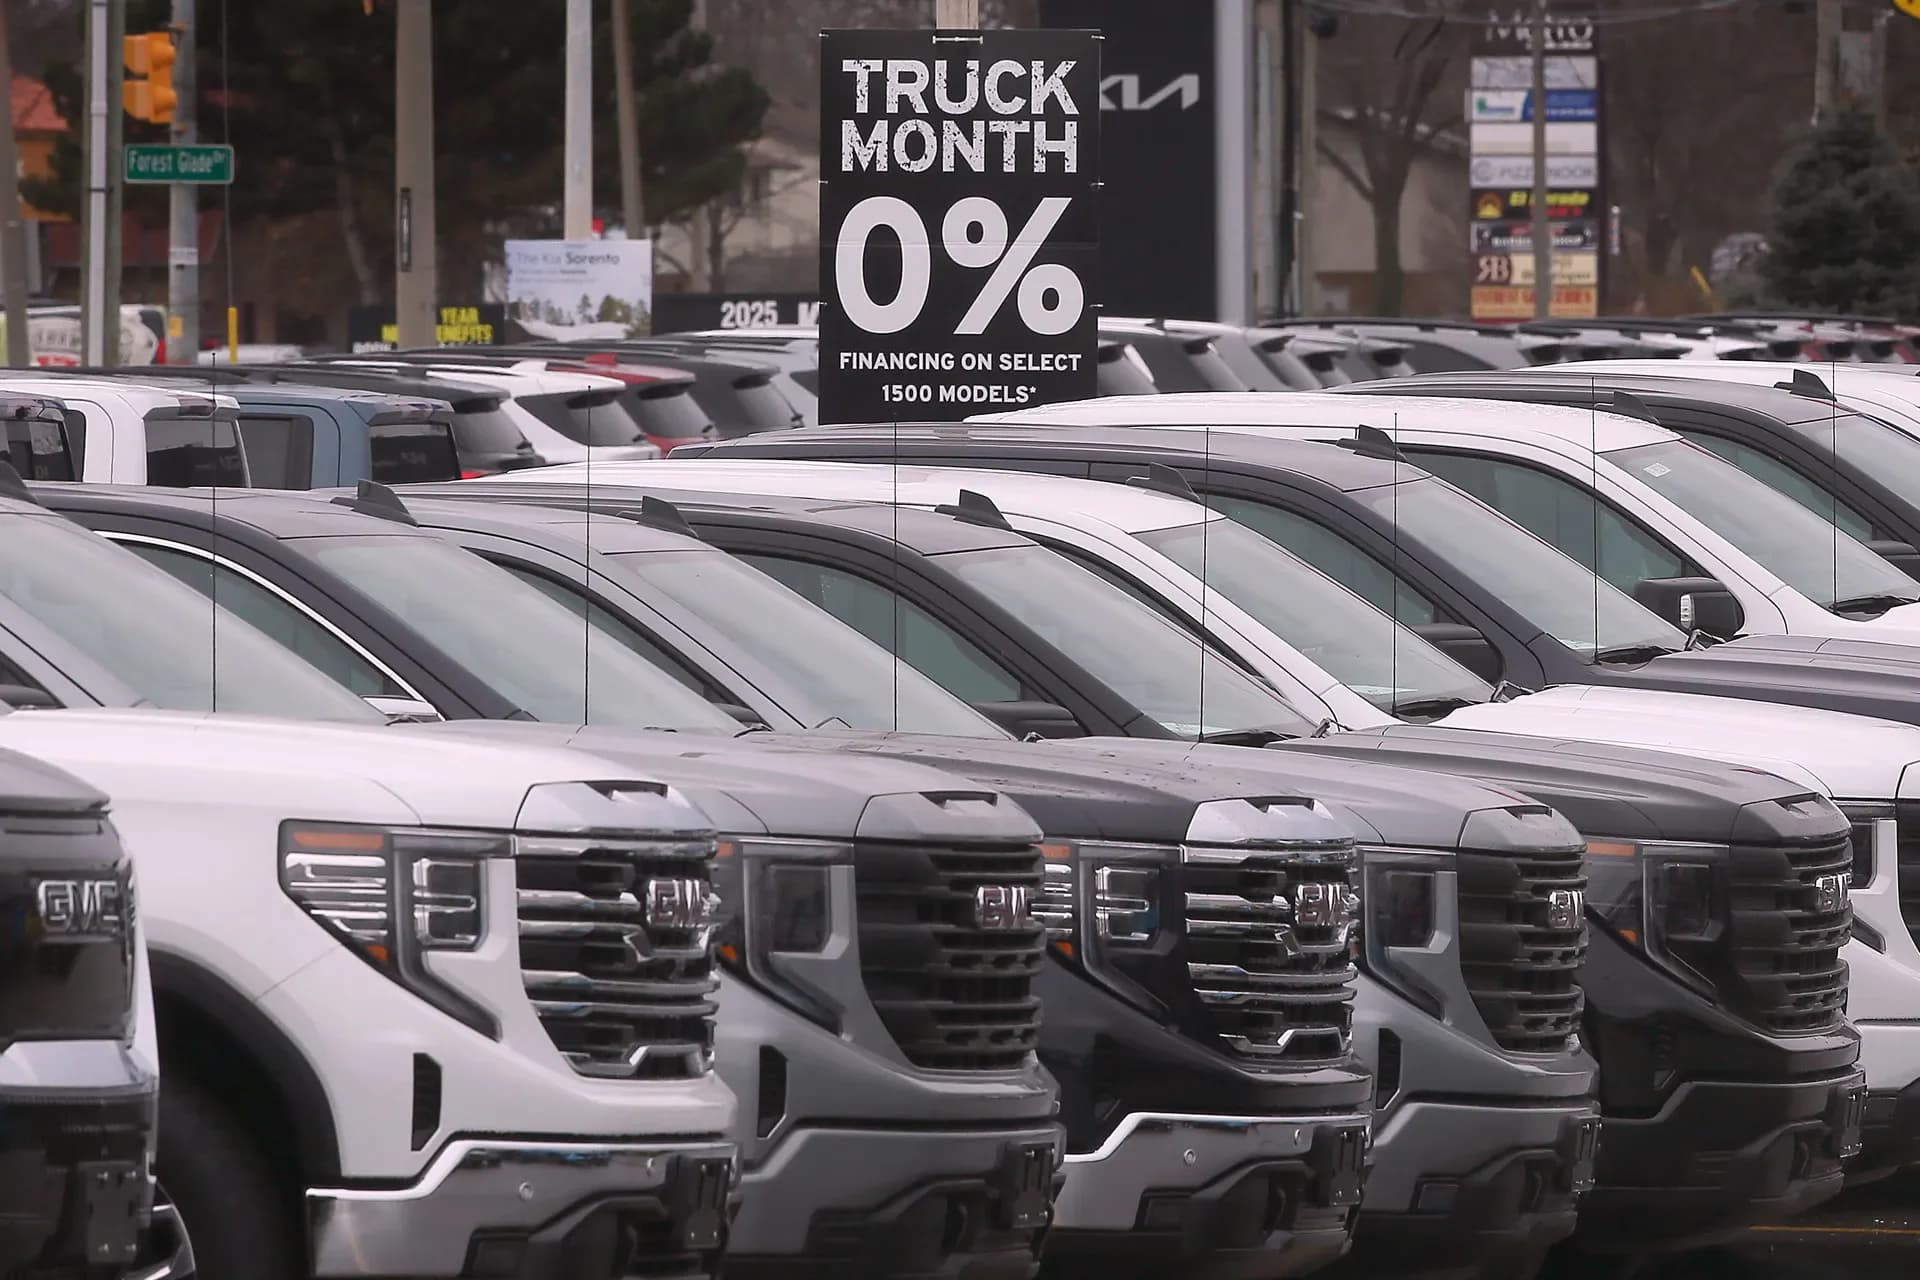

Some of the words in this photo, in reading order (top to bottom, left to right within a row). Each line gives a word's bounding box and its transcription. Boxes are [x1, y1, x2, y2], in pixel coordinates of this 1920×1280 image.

[842, 59, 1080, 115] TRUCK
[841, 119, 1078, 173] MONTH
[128, 149, 173, 173] Forest
[177, 151, 213, 173] Glade
[565, 250, 621, 265] Sorento
[835, 195, 1085, 336] 0%
[440, 307, 479, 325] YEAR
[720, 301, 778, 328] 2025
[435, 325, 494, 342] ENEFITS
[839, 352, 955, 370] FINANCING
[961, 353, 993, 371] ON
[999, 353, 1082, 372] SELECT
[882, 385, 932, 402] 1500
[38, 880, 119, 932] GMC
